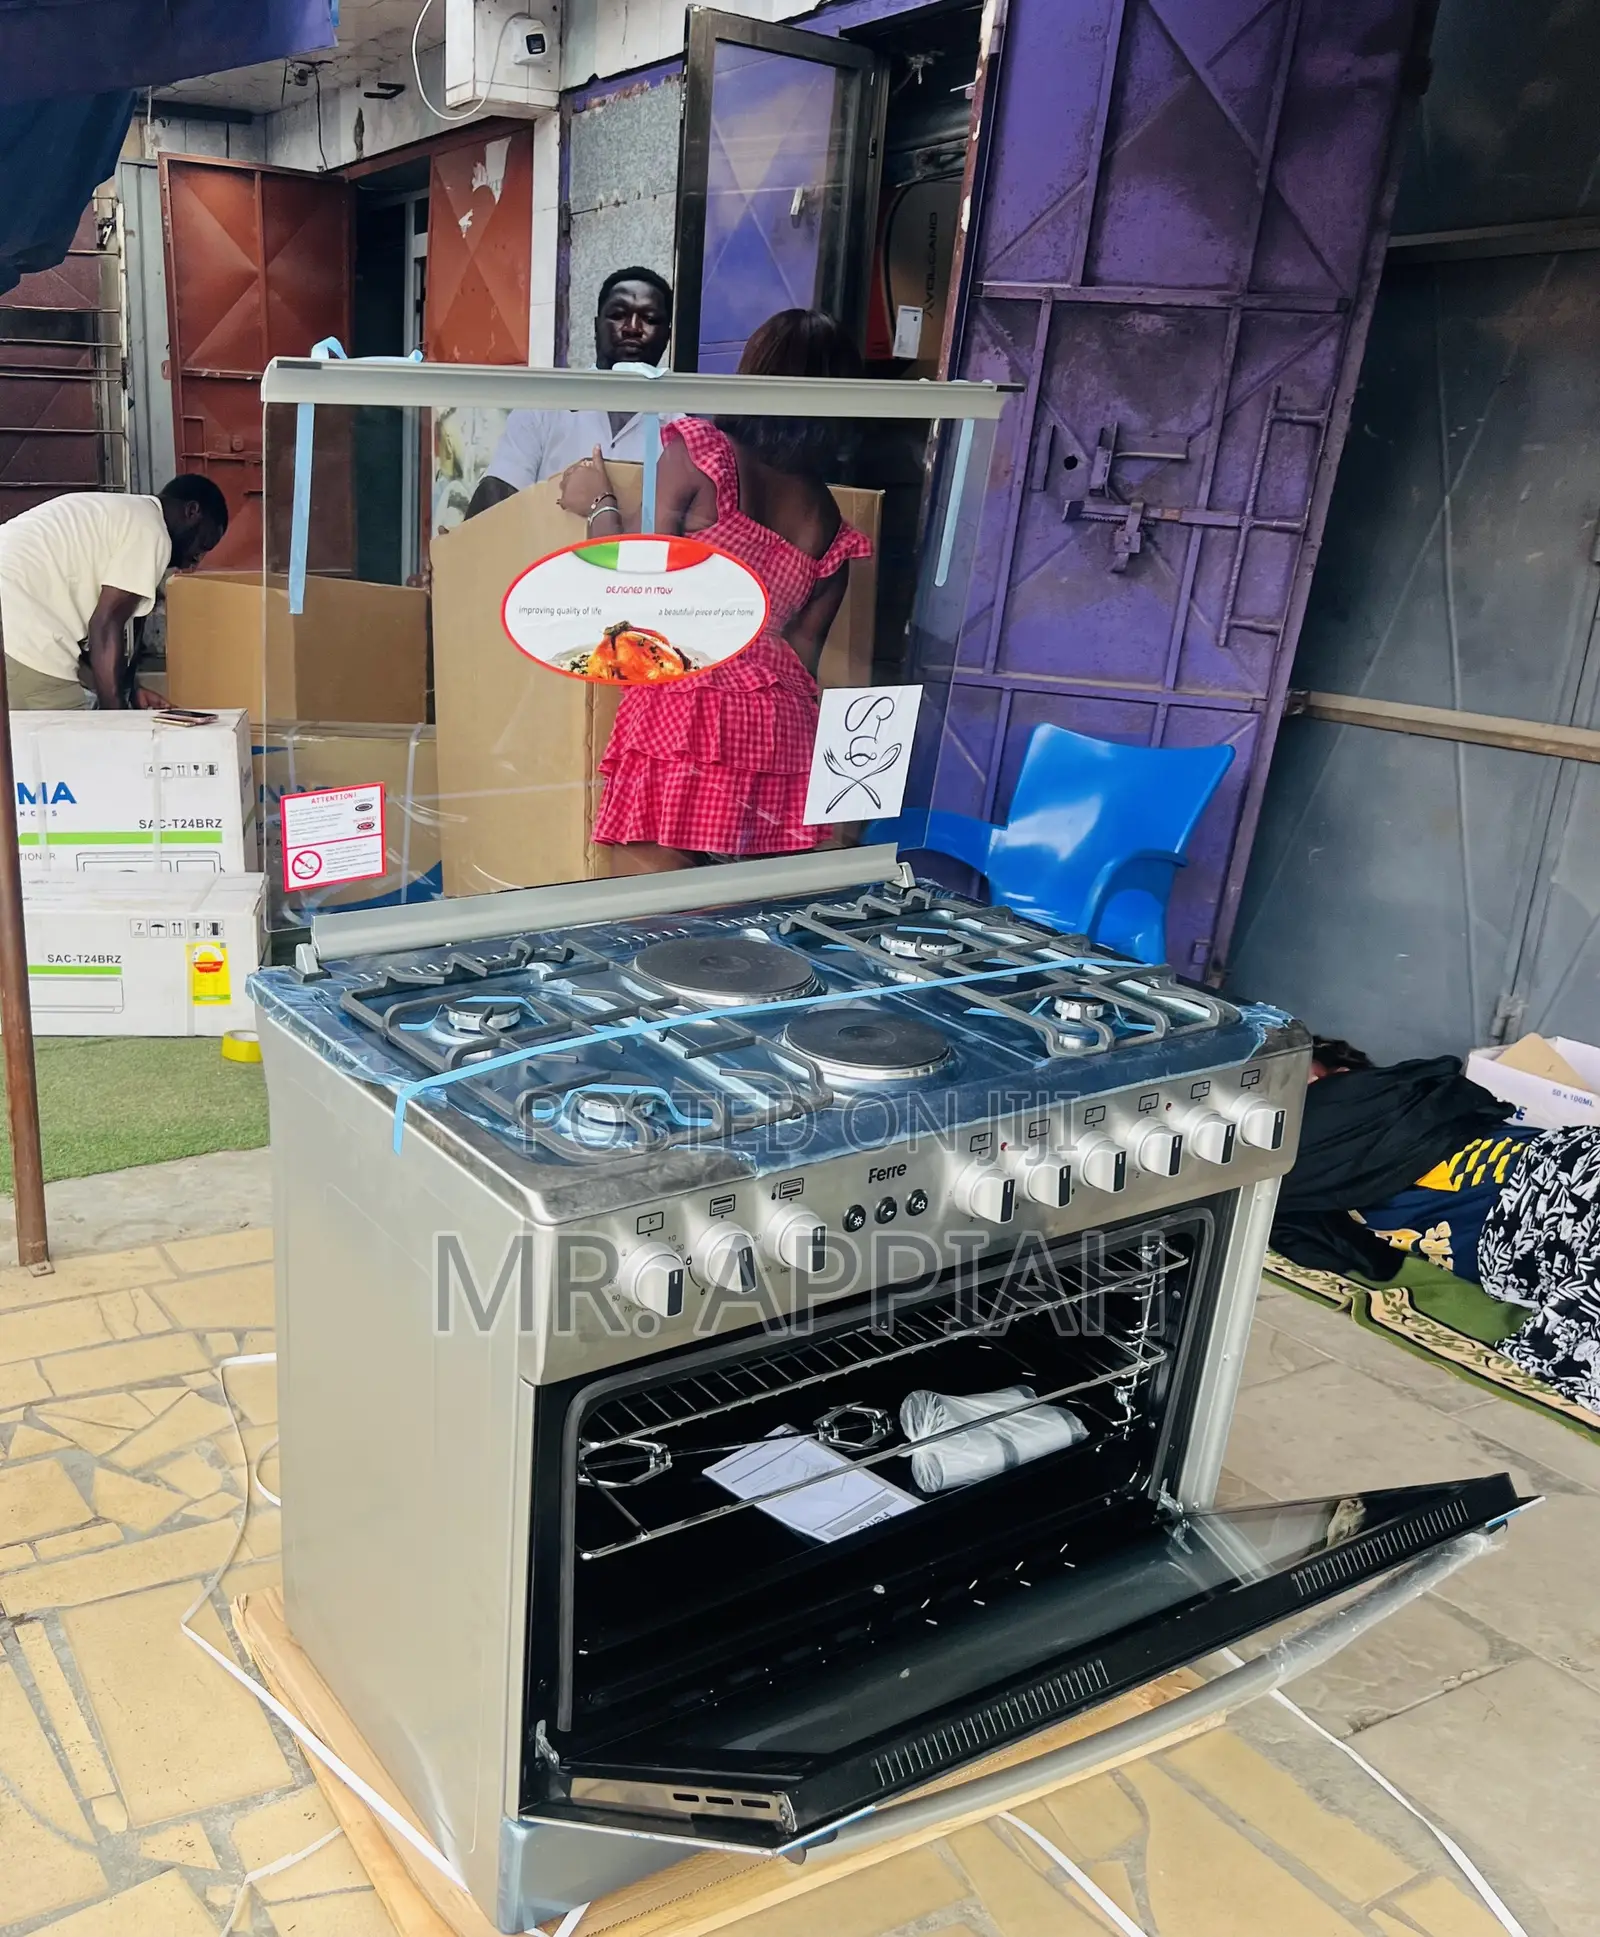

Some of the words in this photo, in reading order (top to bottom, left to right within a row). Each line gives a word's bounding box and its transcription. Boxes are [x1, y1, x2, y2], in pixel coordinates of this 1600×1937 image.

[518, 605, 555, 616] improving
[556, 606, 581, 616] quality
[582, 606, 590, 615] of
[591, 606, 602, 615] life
[713, 608, 721, 616] of
[721, 609, 737, 617] your
[736, 608, 755, 616] home
[311, 792, 357, 804] ATTENTION!
[136, 922, 142, 930] 7
[47, 953, 122, 964] SAC-T24BRZ
[868, 1163, 907, 1184] Ferre
